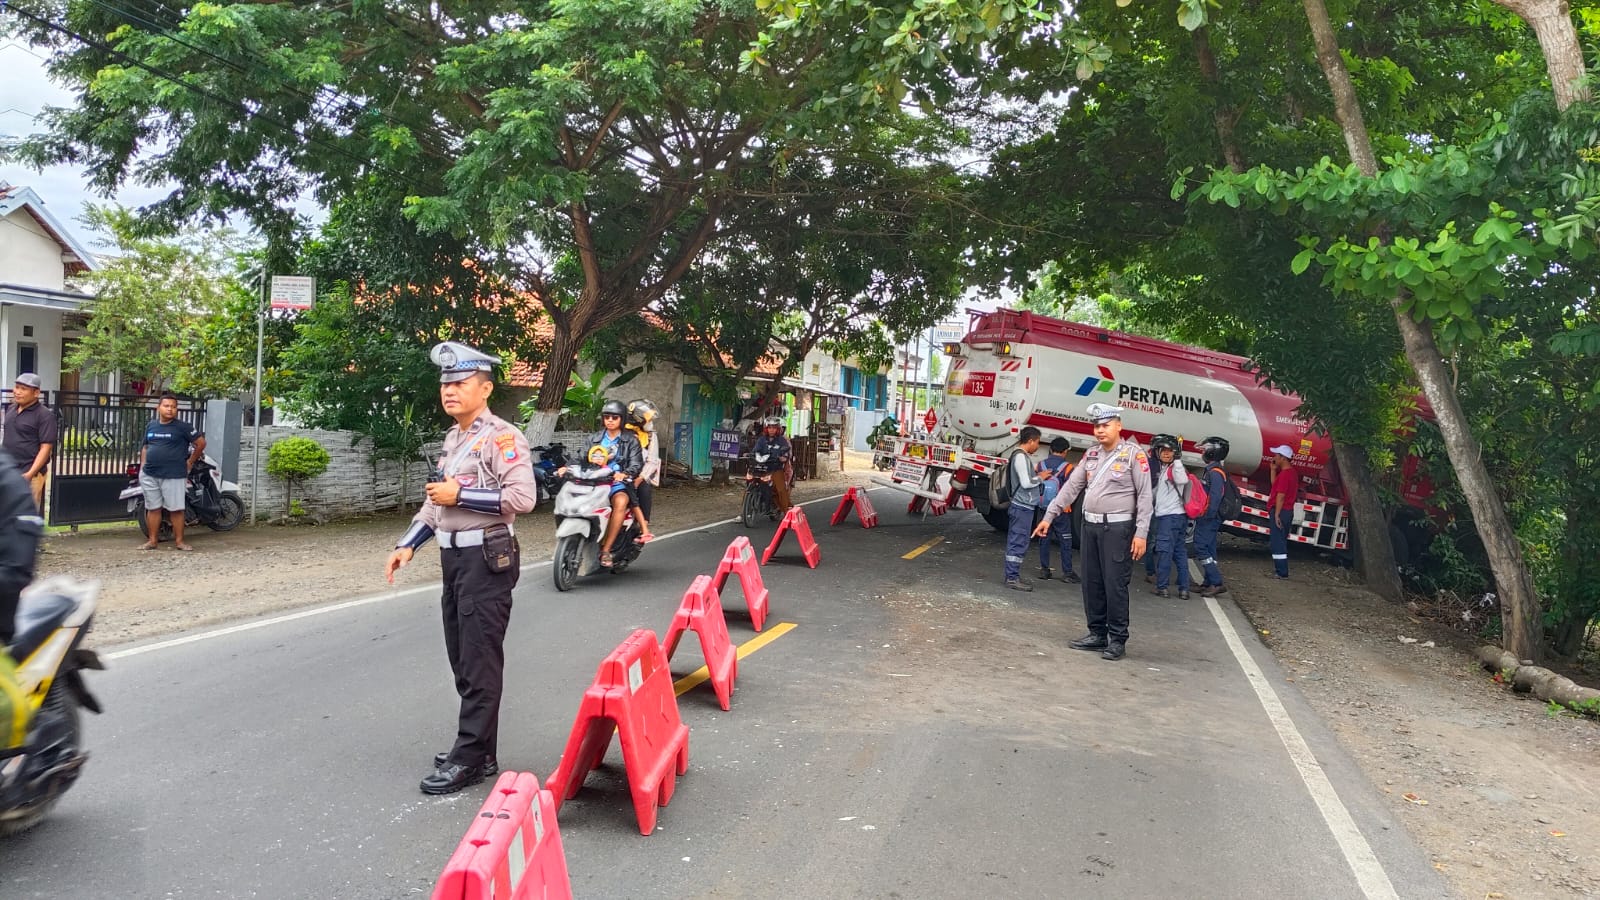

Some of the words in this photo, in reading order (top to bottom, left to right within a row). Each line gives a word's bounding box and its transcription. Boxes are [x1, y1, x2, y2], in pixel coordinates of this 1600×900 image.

[971, 381, 985, 394] 135
[989, 399, 1000, 409] SUB
[1006, 402, 1018, 411] 180
[1119, 384, 1213, 415] PERTAMINA
[1118, 400, 1139, 410] PATRA
[1141, 404, 1165, 415] NIAGA
[1042, 410, 1071, 419] PERTAMINA
[713, 431, 739, 443] SERVIS
